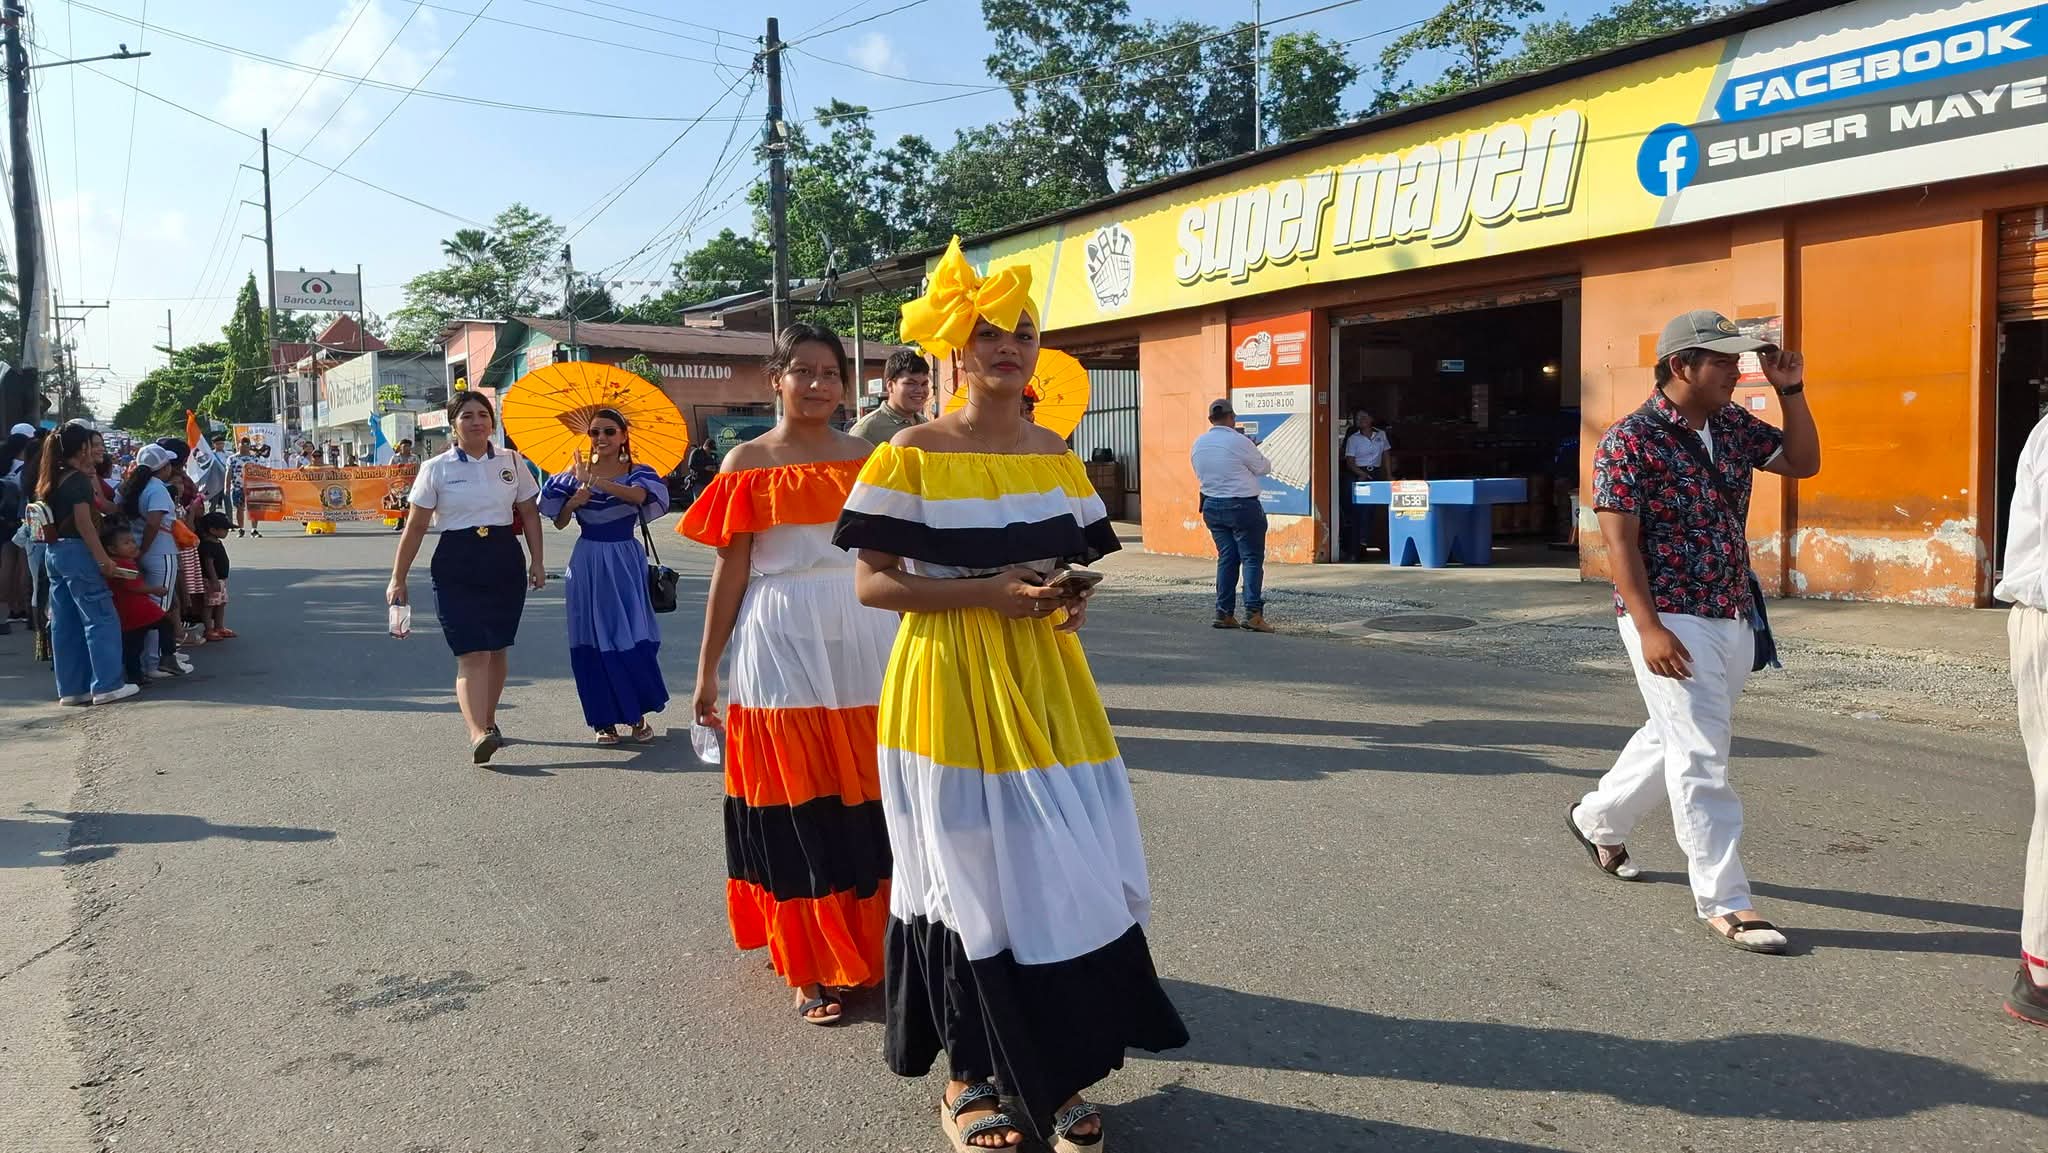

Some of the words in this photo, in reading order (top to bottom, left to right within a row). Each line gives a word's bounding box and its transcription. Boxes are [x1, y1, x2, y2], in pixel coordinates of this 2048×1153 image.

[1734, 17, 2034, 111] FACEBOOK
[1707, 113, 1868, 167] SUPER
[1174, 170, 1338, 286] super
[1333, 109, 1587, 254] mayen
[283, 295, 316, 305] Banco
[318, 297, 355, 306] Azteca
[1257, 398, 1295, 409] 2301-8100
[326, 470, 352, 480] Mixto
[354, 468, 387, 480] Mundo
